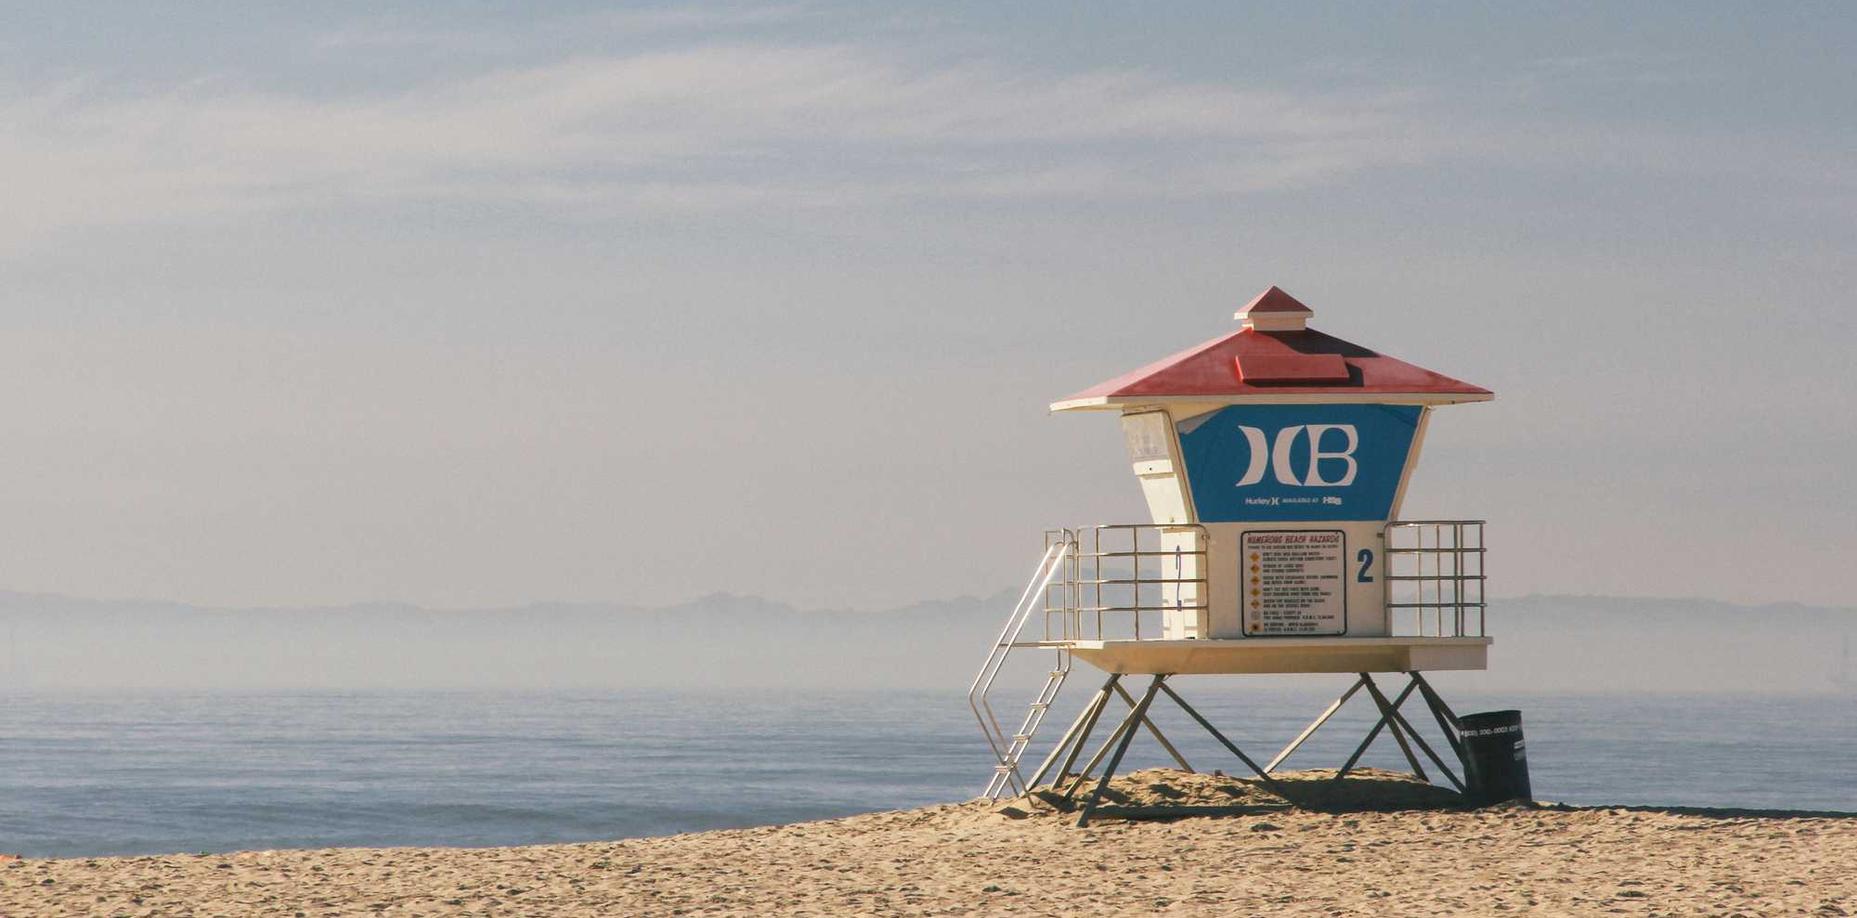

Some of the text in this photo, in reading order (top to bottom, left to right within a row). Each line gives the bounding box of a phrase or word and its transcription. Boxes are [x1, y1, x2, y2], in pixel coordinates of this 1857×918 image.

[1245, 497, 1271, 505] Hurley
[1285, 535, 1307, 544] BEACH
[1309, 535, 1340, 543] HAZARDS
[1357, 548, 1374, 583] 2
